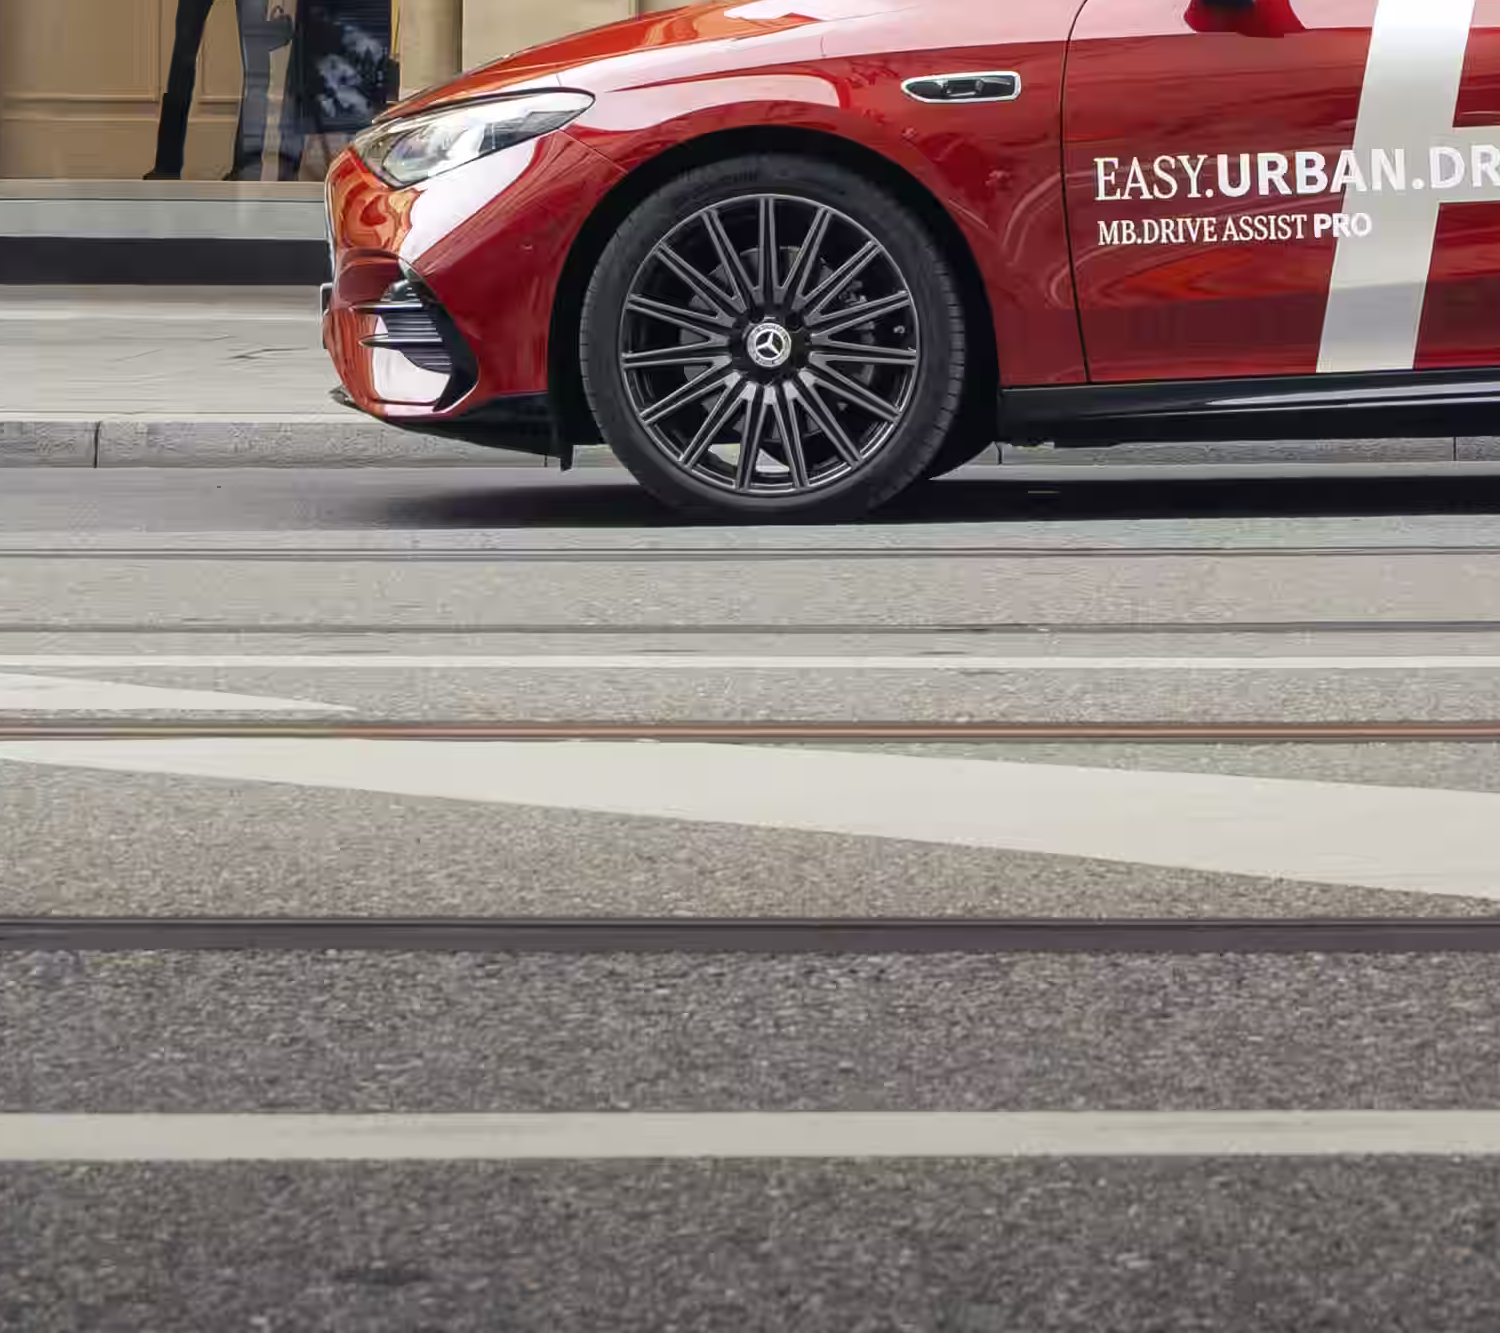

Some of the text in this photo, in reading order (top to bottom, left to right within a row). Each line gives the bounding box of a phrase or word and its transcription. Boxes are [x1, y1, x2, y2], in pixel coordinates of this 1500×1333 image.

[1097, 212, 1373, 246] MB.DRIVE ASSIST PRO
